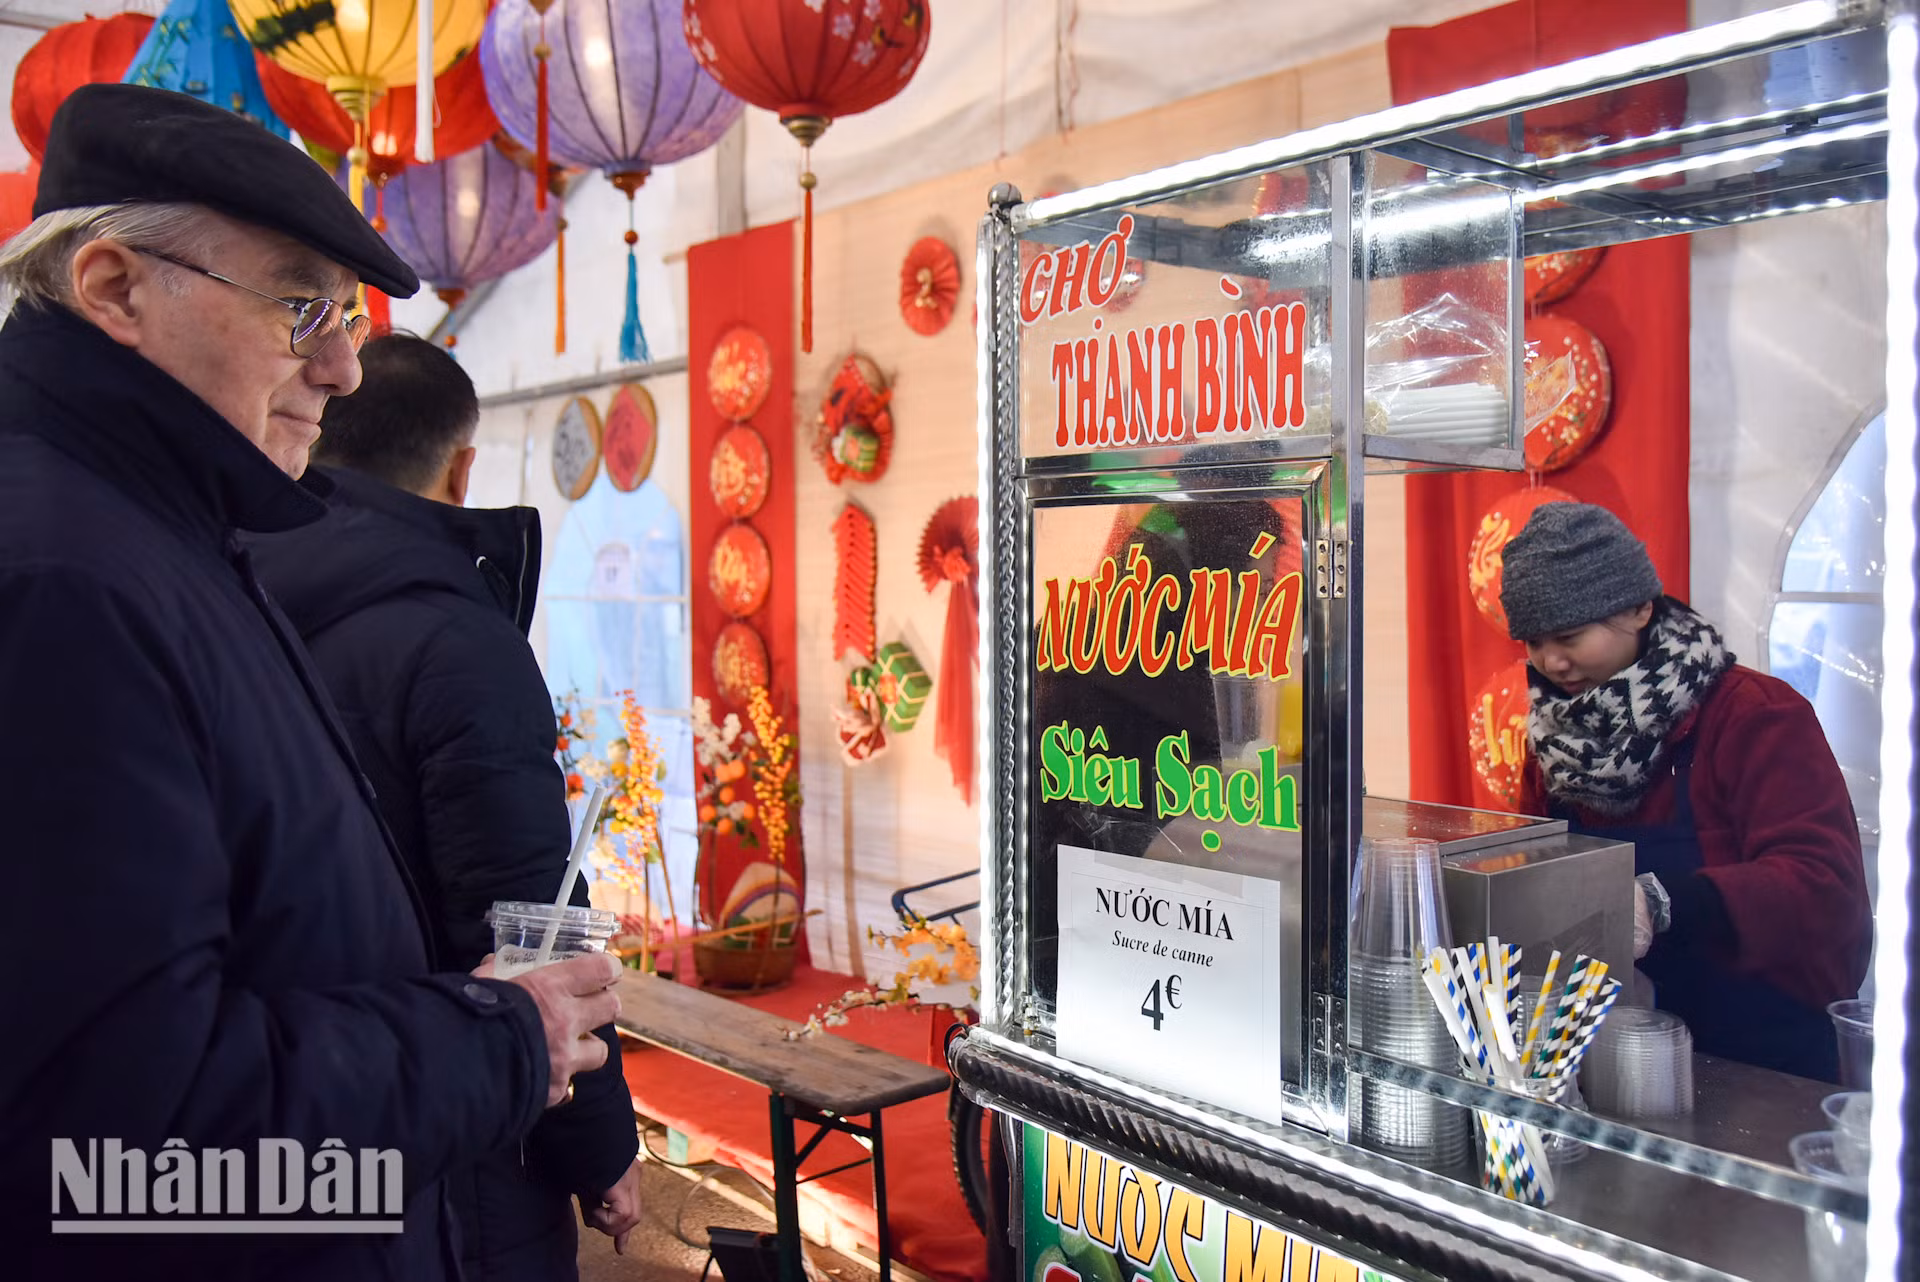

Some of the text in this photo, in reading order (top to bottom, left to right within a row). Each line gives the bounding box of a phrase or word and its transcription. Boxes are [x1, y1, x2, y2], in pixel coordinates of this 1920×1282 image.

[1019, 214, 1134, 331] CHỢ
[1194, 275, 1307, 434] BÌNH
[1037, 543, 1181, 678] NƯỚC
[1177, 531, 1303, 682] MÍA
[1040, 720, 1302, 852] Siêu Sạch
[1096, 887, 1235, 941] NƯỚC MÍA
[1112, 930, 1214, 968] Sucre de canne
[1141, 974, 1183, 1031] 4€
